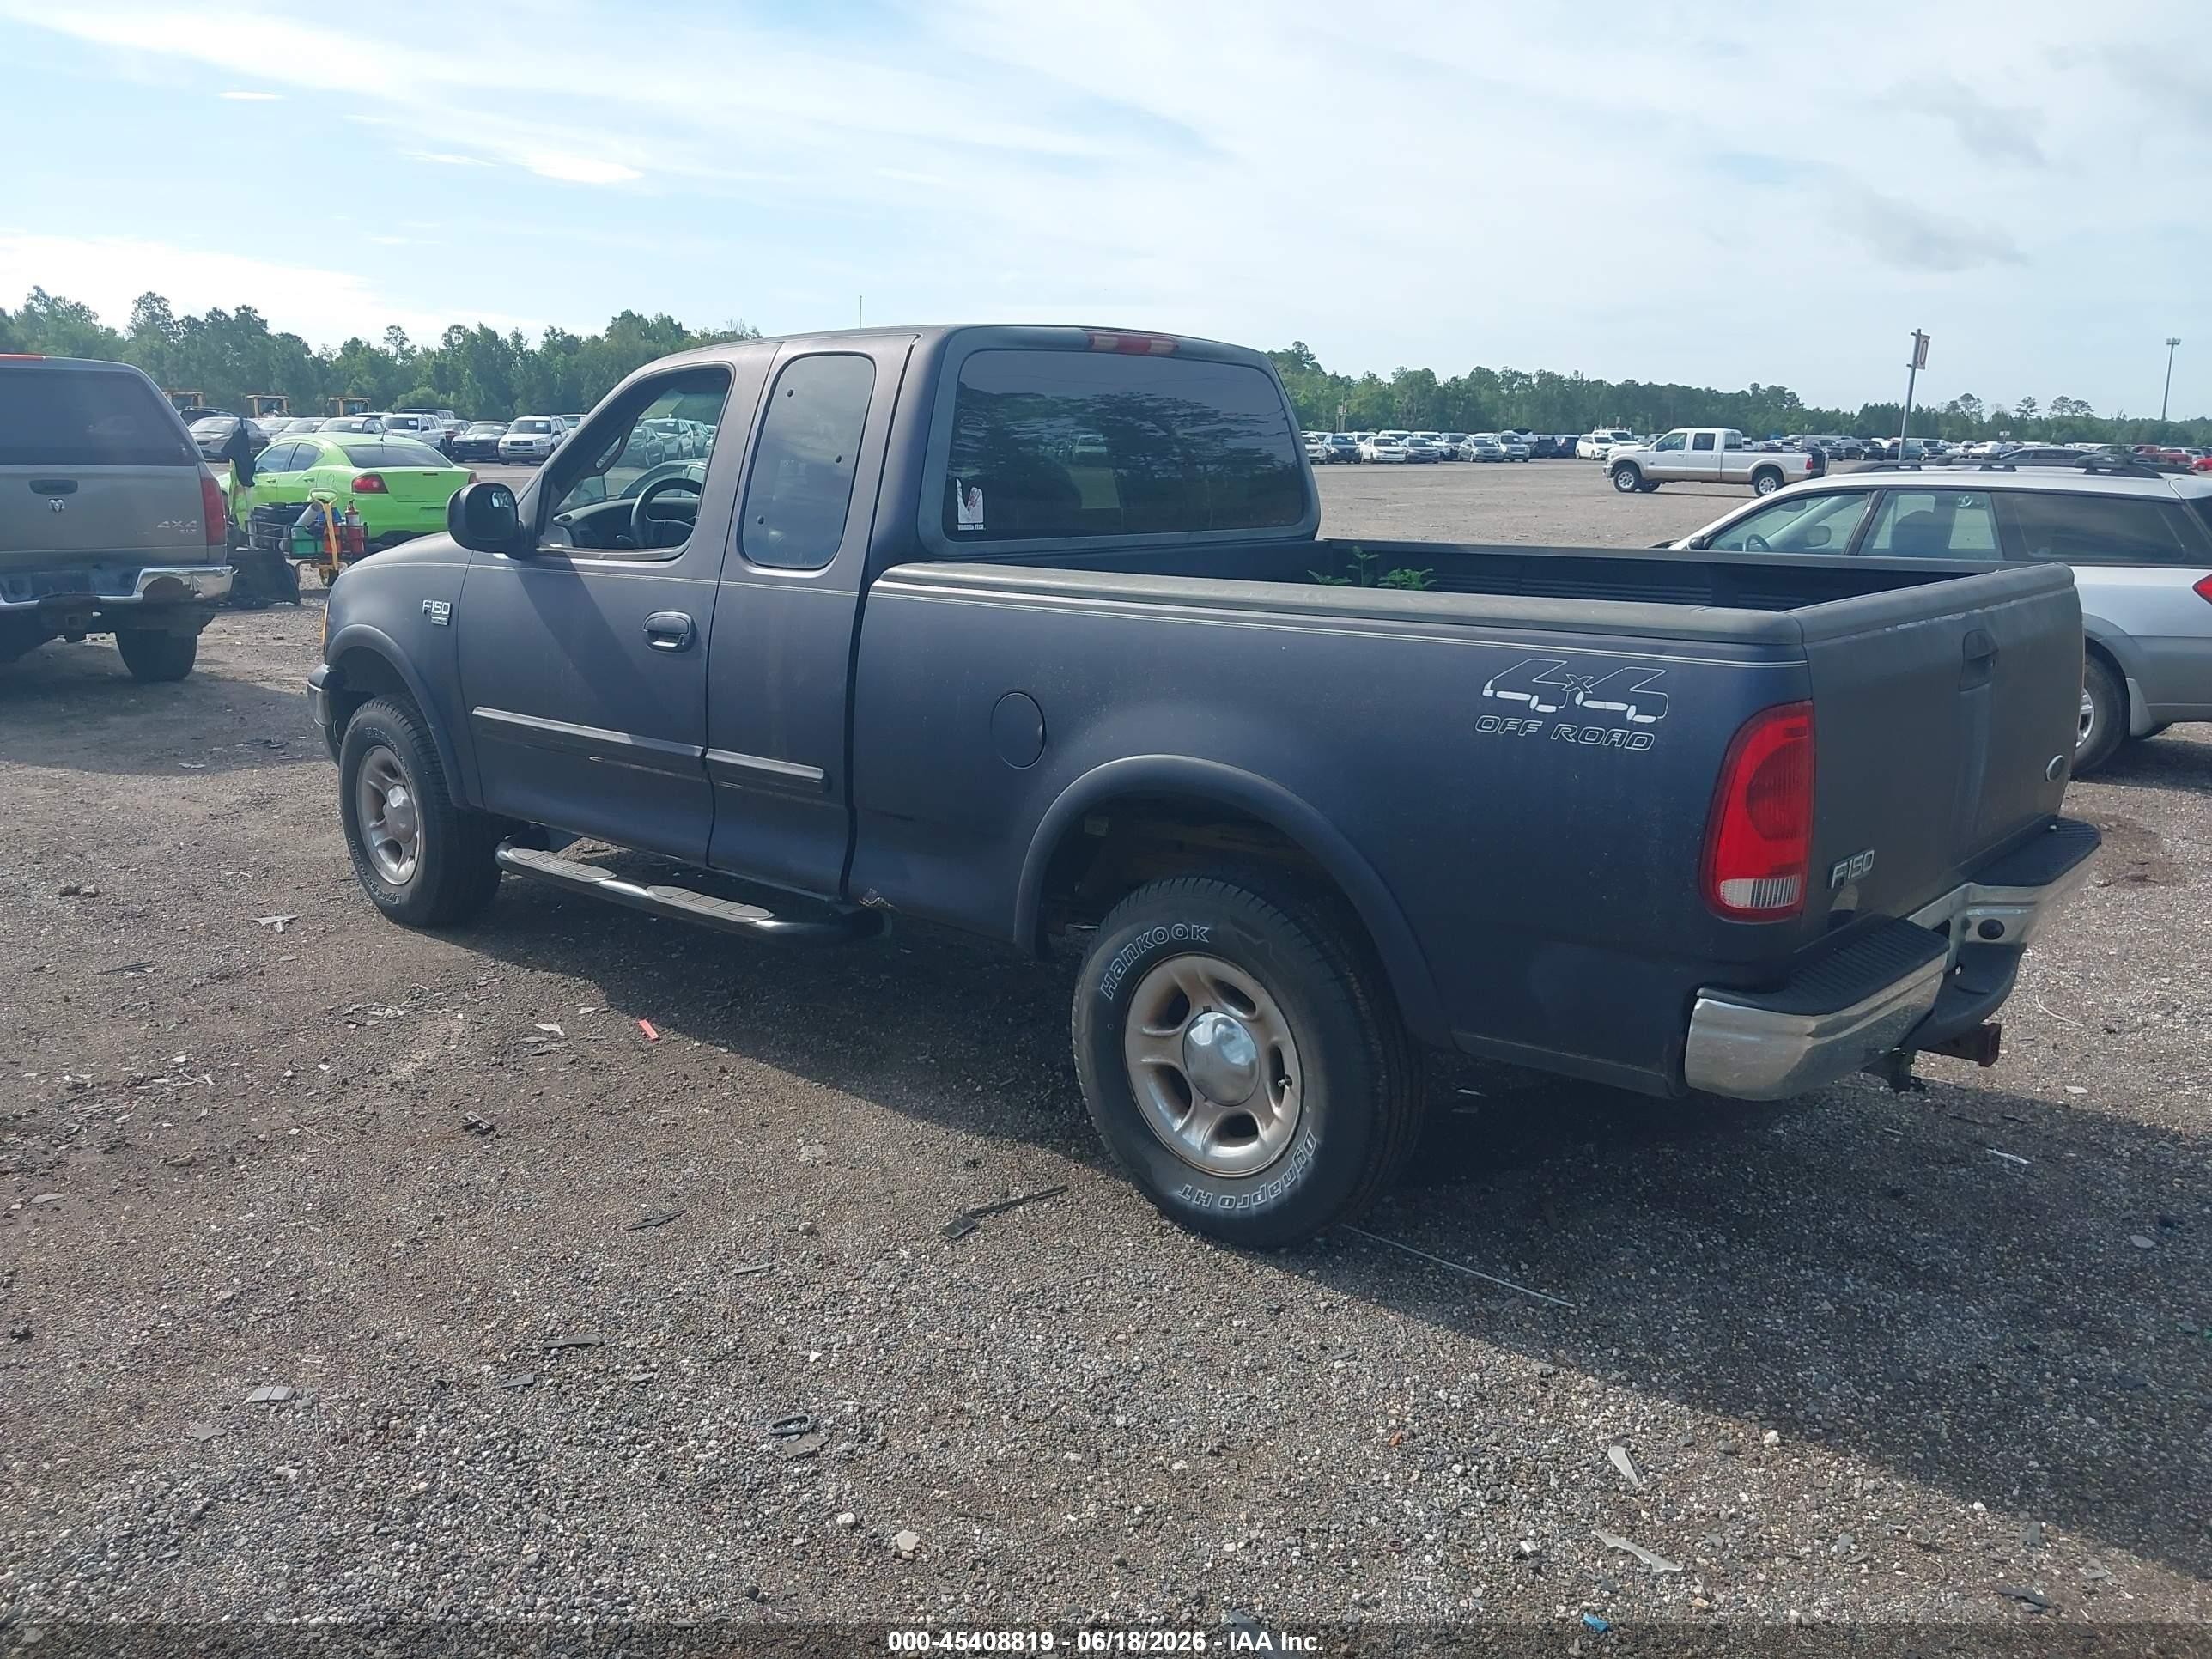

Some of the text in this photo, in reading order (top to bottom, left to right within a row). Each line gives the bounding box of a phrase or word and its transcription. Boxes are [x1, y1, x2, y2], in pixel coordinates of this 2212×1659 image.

[1474, 714, 1656, 751] OFF ROAD
[1177, 1126, 1317, 1209] Dynapro HT
